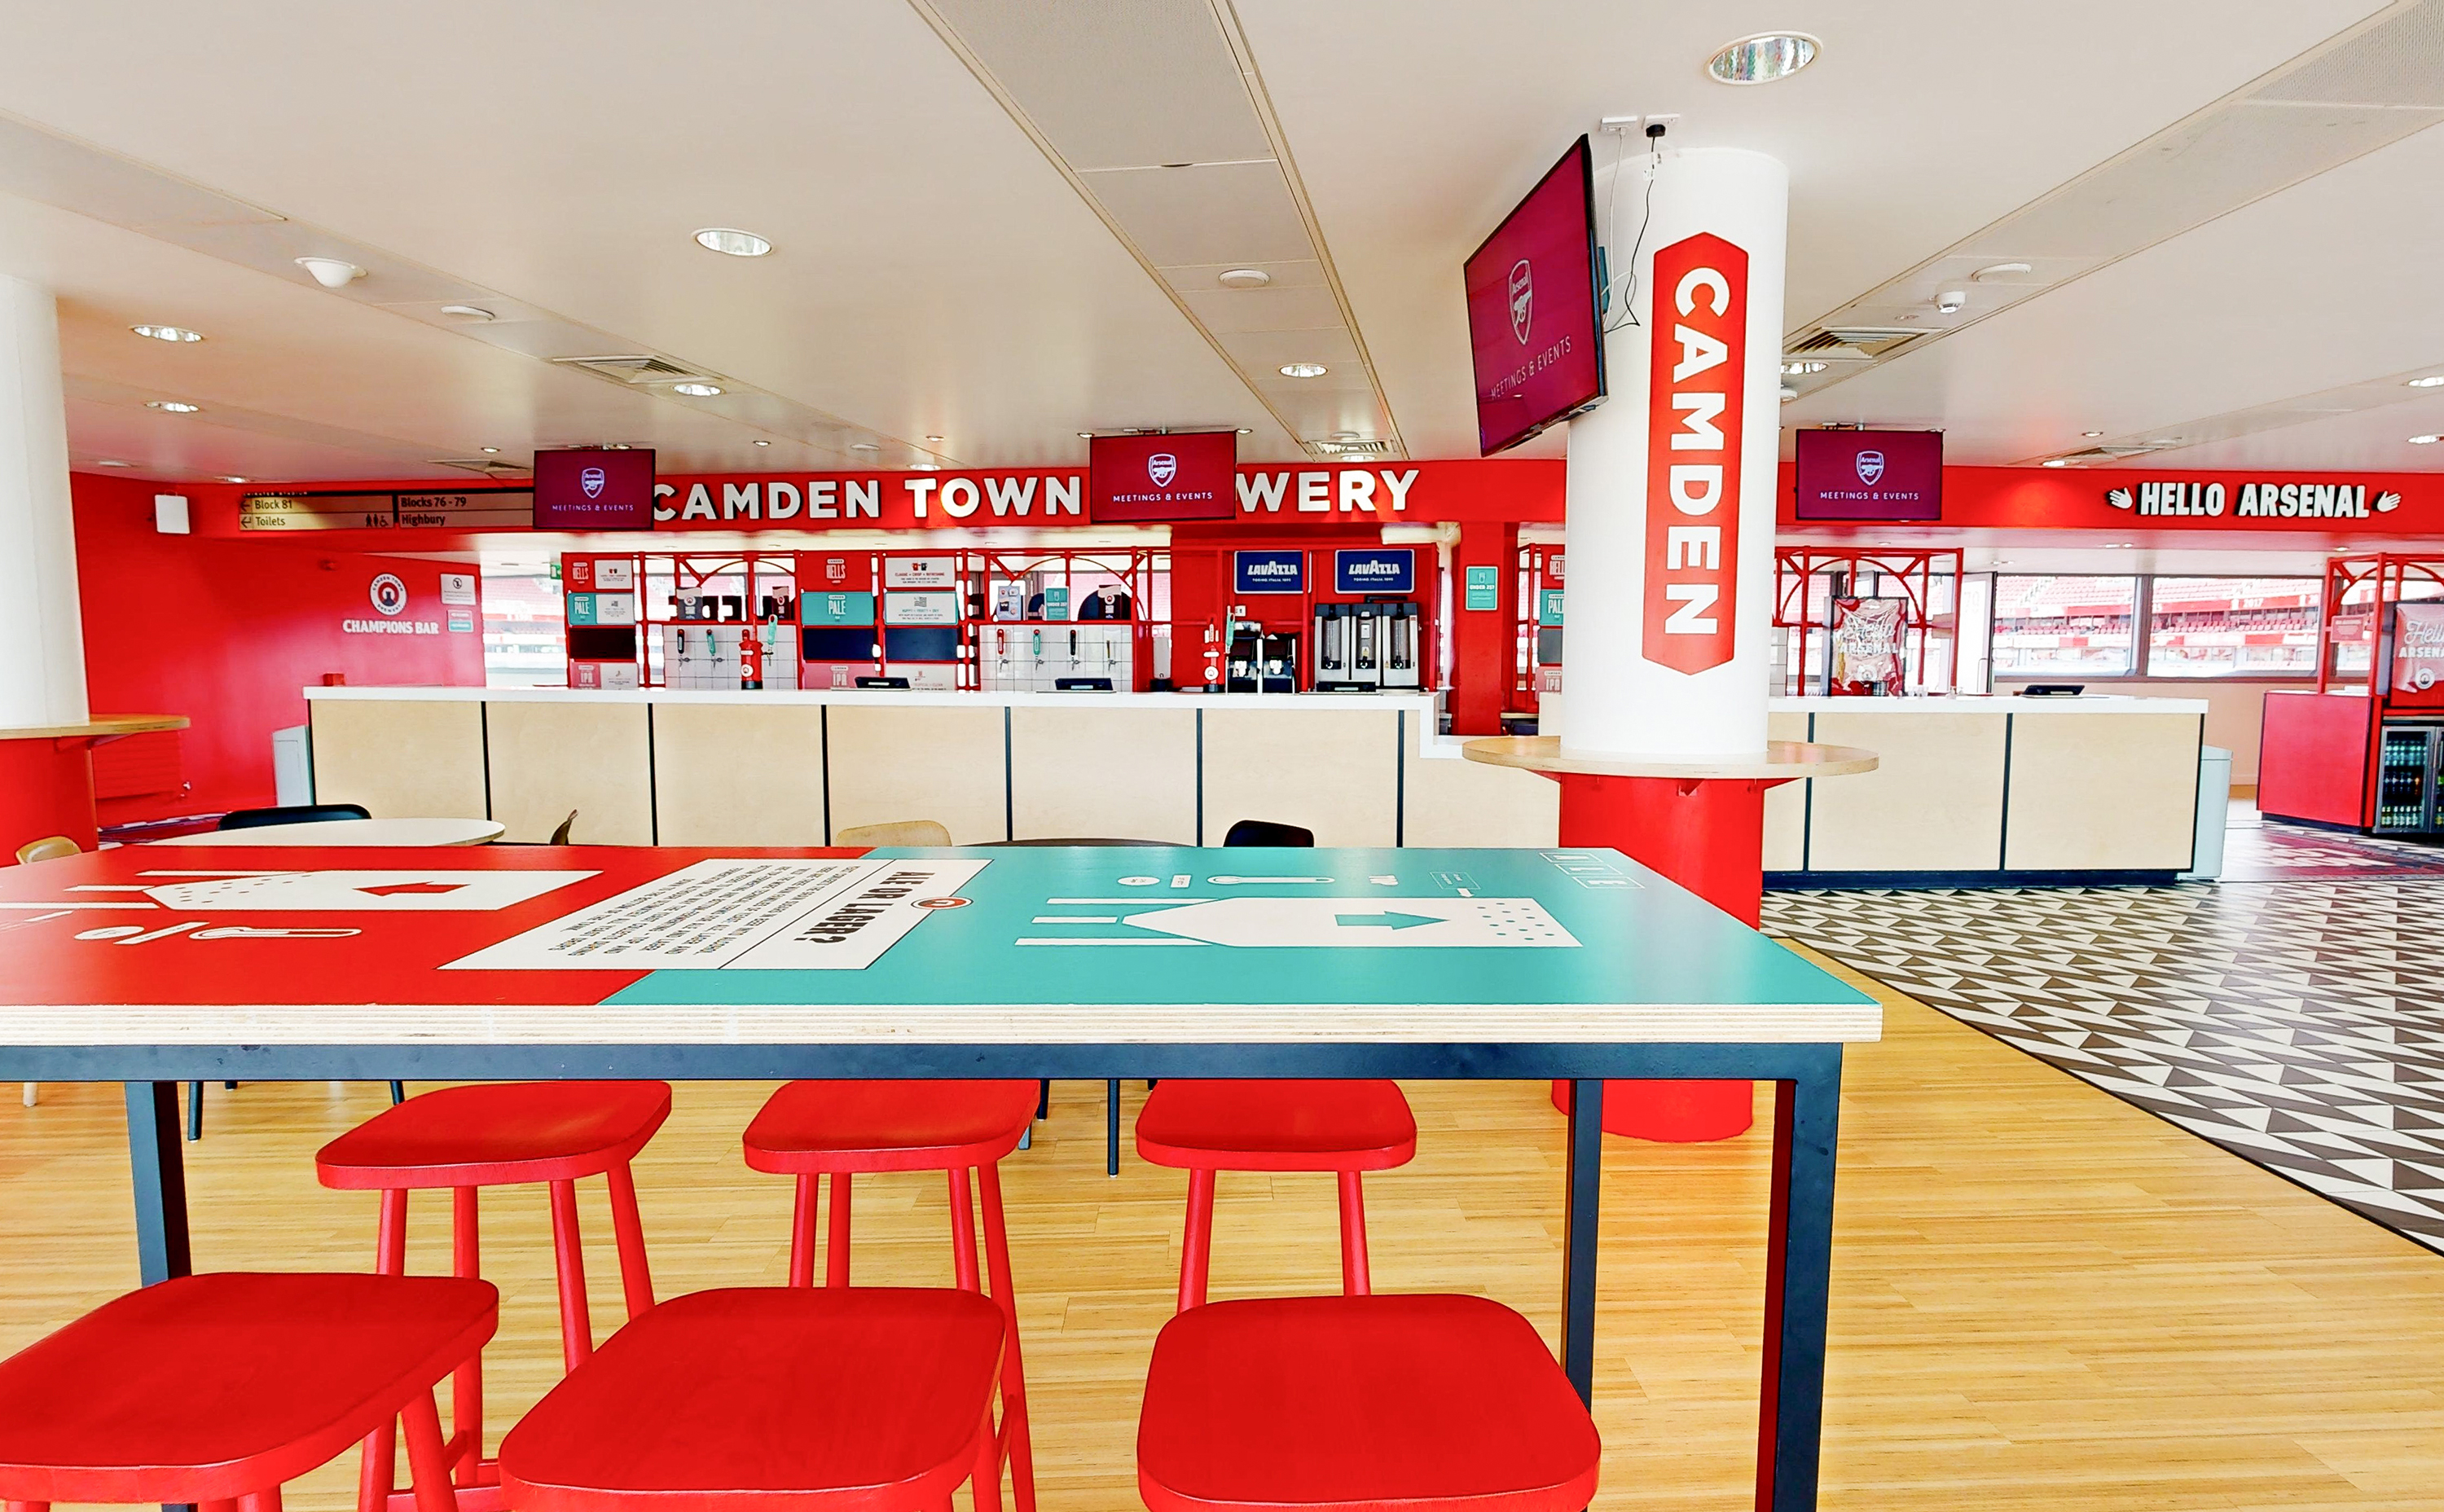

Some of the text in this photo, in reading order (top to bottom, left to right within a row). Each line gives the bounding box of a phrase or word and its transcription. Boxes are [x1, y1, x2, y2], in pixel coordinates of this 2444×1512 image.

[1490, 336, 1571, 399] MEETINGS & EVENTS
[1664, 267, 1731, 635] CAMDEN
[653, 468, 1420, 521] CAMDEN TOWN WERY
[1113, 492, 1213, 502] MEETINGS & EVENTS
[1820, 491, 1869, 499] MEETINGS
[1884, 492, 1919, 500] EVENTS
[2140, 481, 2370, 518] HELLO ARSENAL
[254, 499, 292, 509] Block 81
[401, 497, 433, 508] Blocks
[434, 497, 446, 507] 76
[455, 497, 467, 507] 79
[256, 516, 286, 526] Toilets
[402, 514, 446, 527] Highbury
[826, 565, 846, 578] HELLS
[1247, 560, 1298, 576] LAVAZZA
[1348, 560, 1400, 575] LAVAZZA
[574, 601, 590, 615] PALE
[828, 600, 846, 615] PALE
[342, 619, 439, 635] CHAMPIONS BAR
[1839, 642, 1898, 654] ARSENAL
[833, 673, 847, 686] IPA
[1546, 678, 1561, 691] IPA
[793, 872, 935, 943] ALE OR LAGER?
